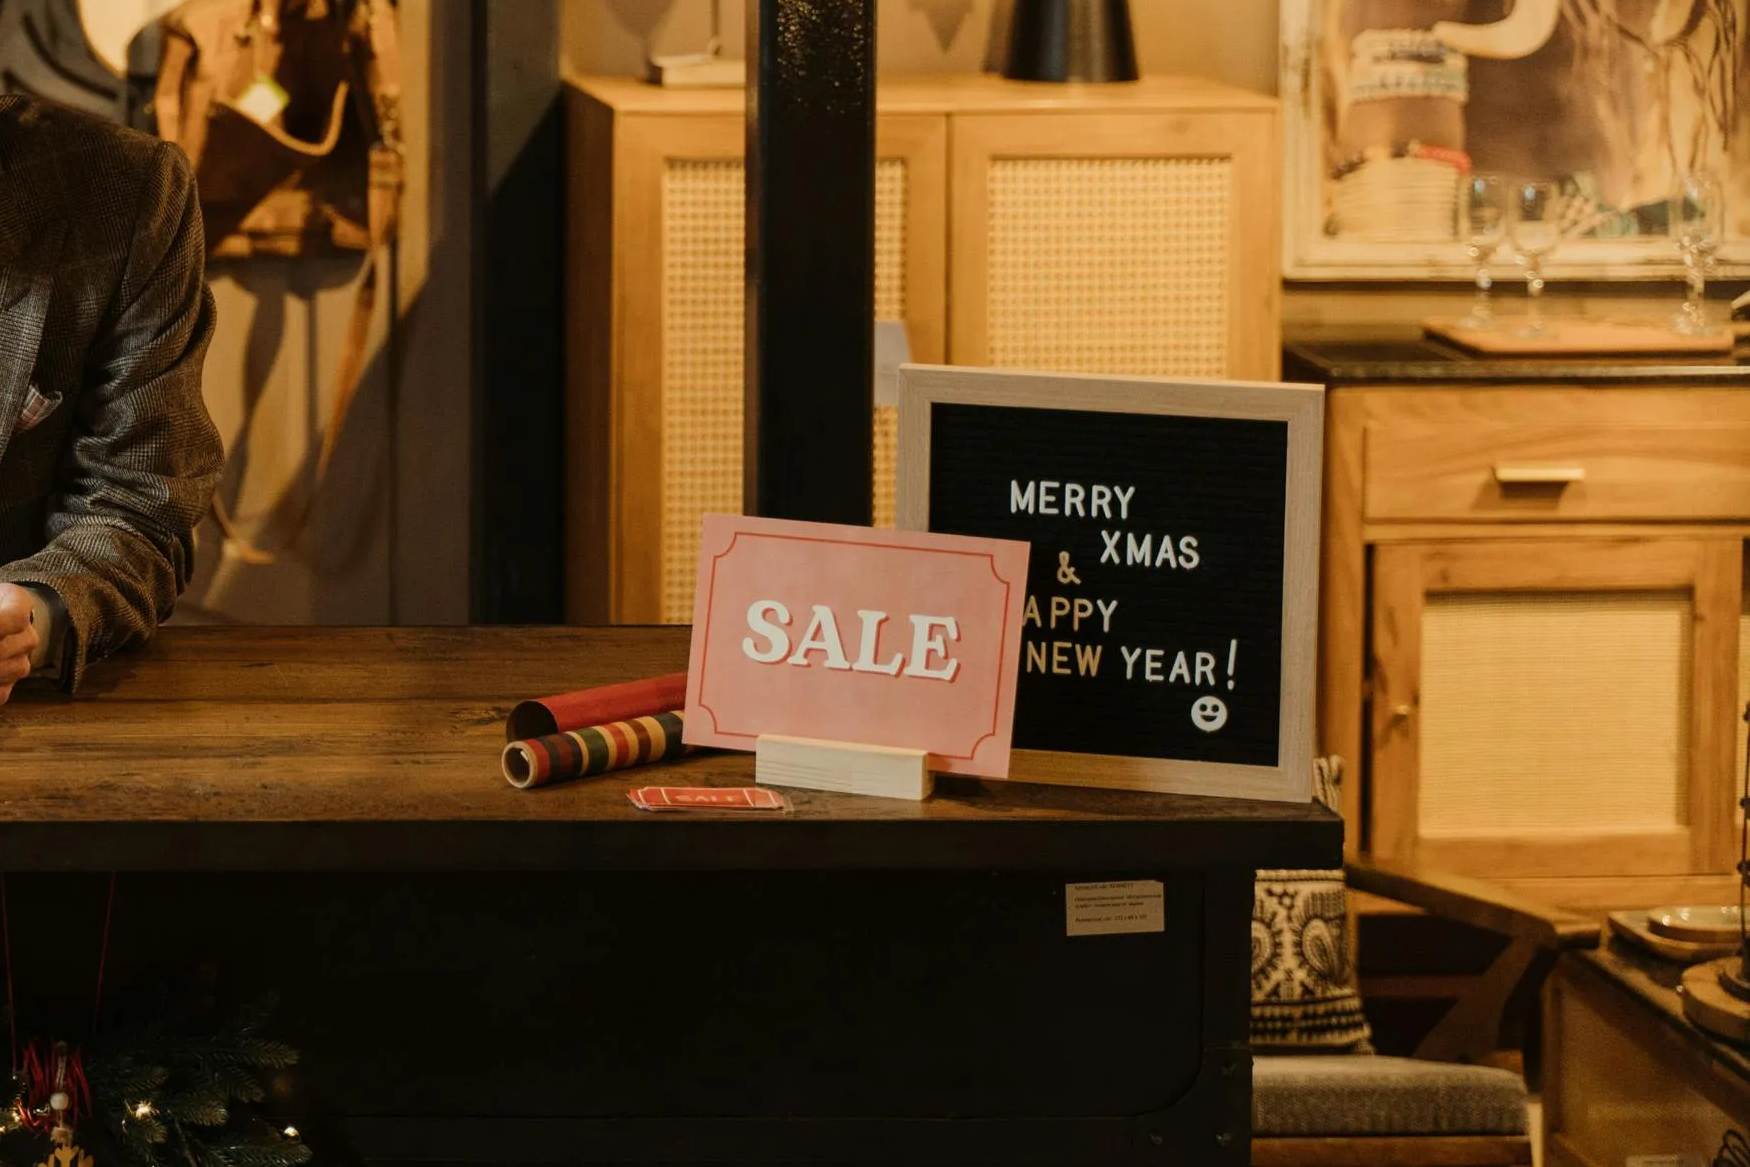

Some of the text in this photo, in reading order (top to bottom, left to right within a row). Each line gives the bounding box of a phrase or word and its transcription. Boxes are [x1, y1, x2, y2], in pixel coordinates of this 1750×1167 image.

[1010, 479, 1136, 519] MERRY
[1056, 551, 1082, 585] &
[1100, 530, 1200, 569] XMAS
[1021, 595, 1118, 633] APPY
[741, 599, 961, 683] SALE
[1026, 639, 1238, 691] NEW YEAR!
[674, 794, 741, 803] SALE
